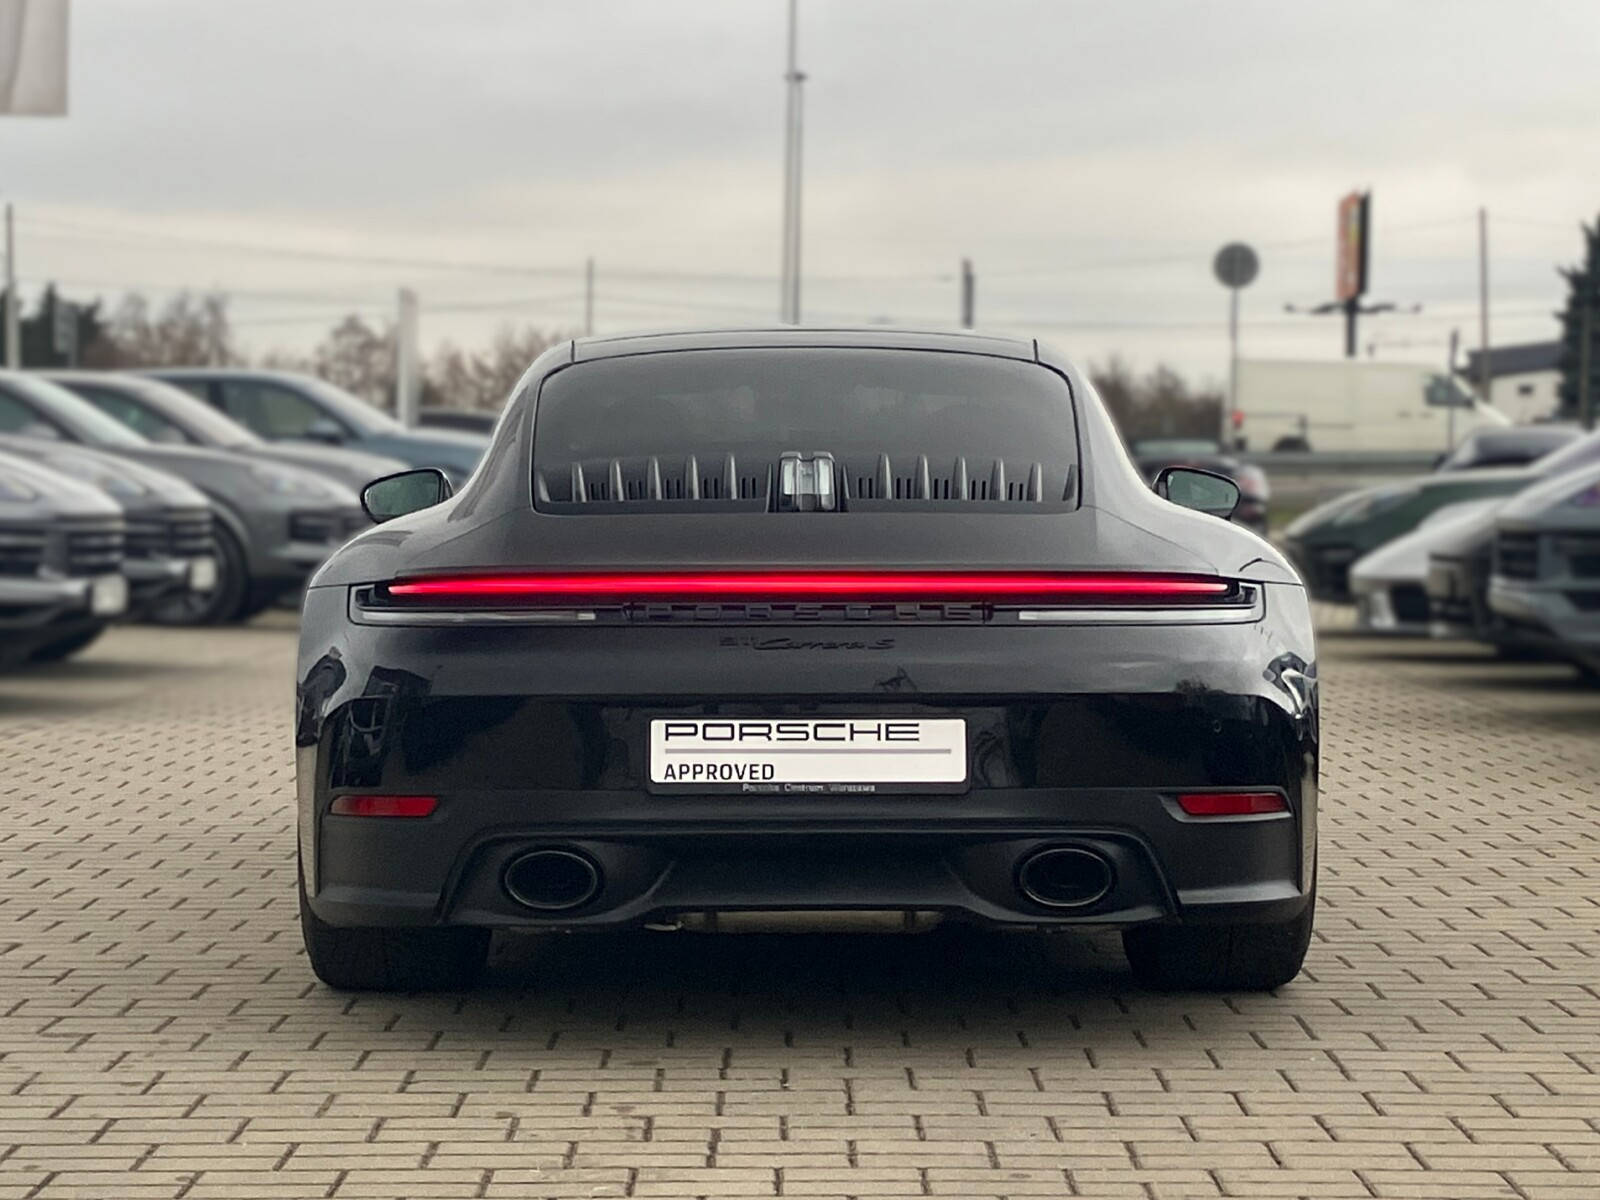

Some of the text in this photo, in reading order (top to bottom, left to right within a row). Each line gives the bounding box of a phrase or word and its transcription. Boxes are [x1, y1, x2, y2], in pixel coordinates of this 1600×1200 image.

[646, 602, 972, 621] PORSCHE
[867, 638, 895, 650] S
[665, 722, 920, 742] PORSCHE
[664, 763, 775, 781] APPROVED
